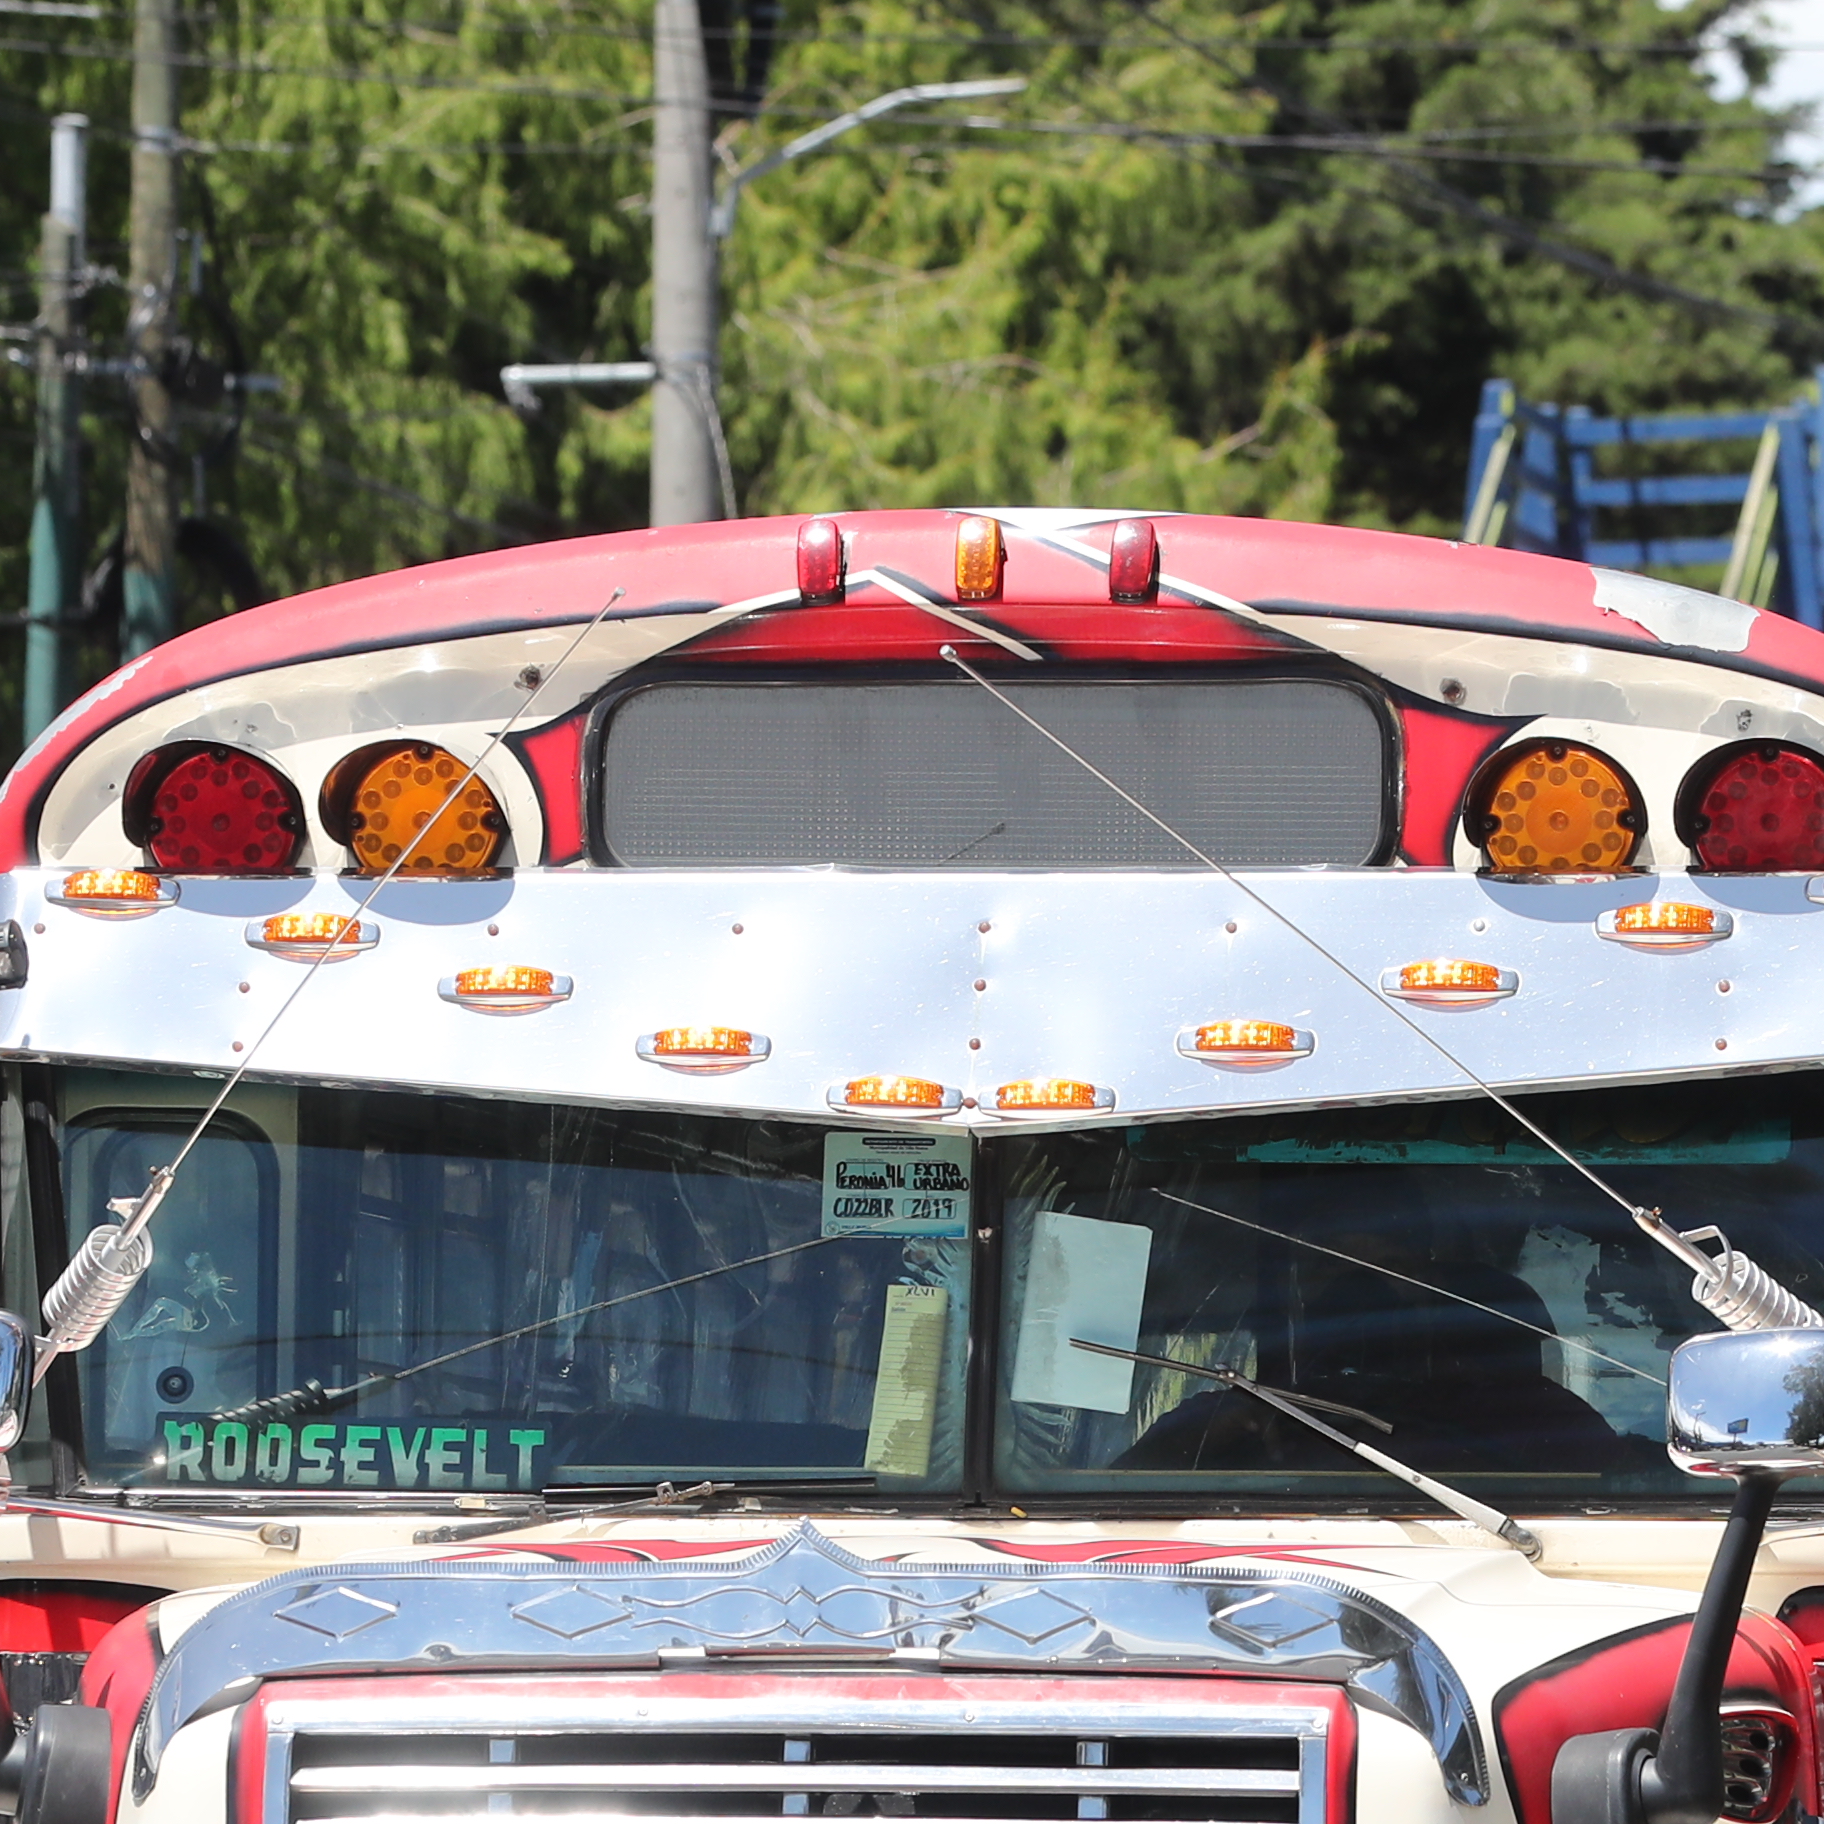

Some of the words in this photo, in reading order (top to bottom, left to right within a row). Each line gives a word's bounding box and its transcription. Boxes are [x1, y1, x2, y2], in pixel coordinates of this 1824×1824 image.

[914, 1162, 961, 1177] EXTRA
[913, 1177, 969, 1190] URBANO
[911, 1198, 953, 1219] 2019
[163, 1419, 545, 1487] ROOSEVELT
